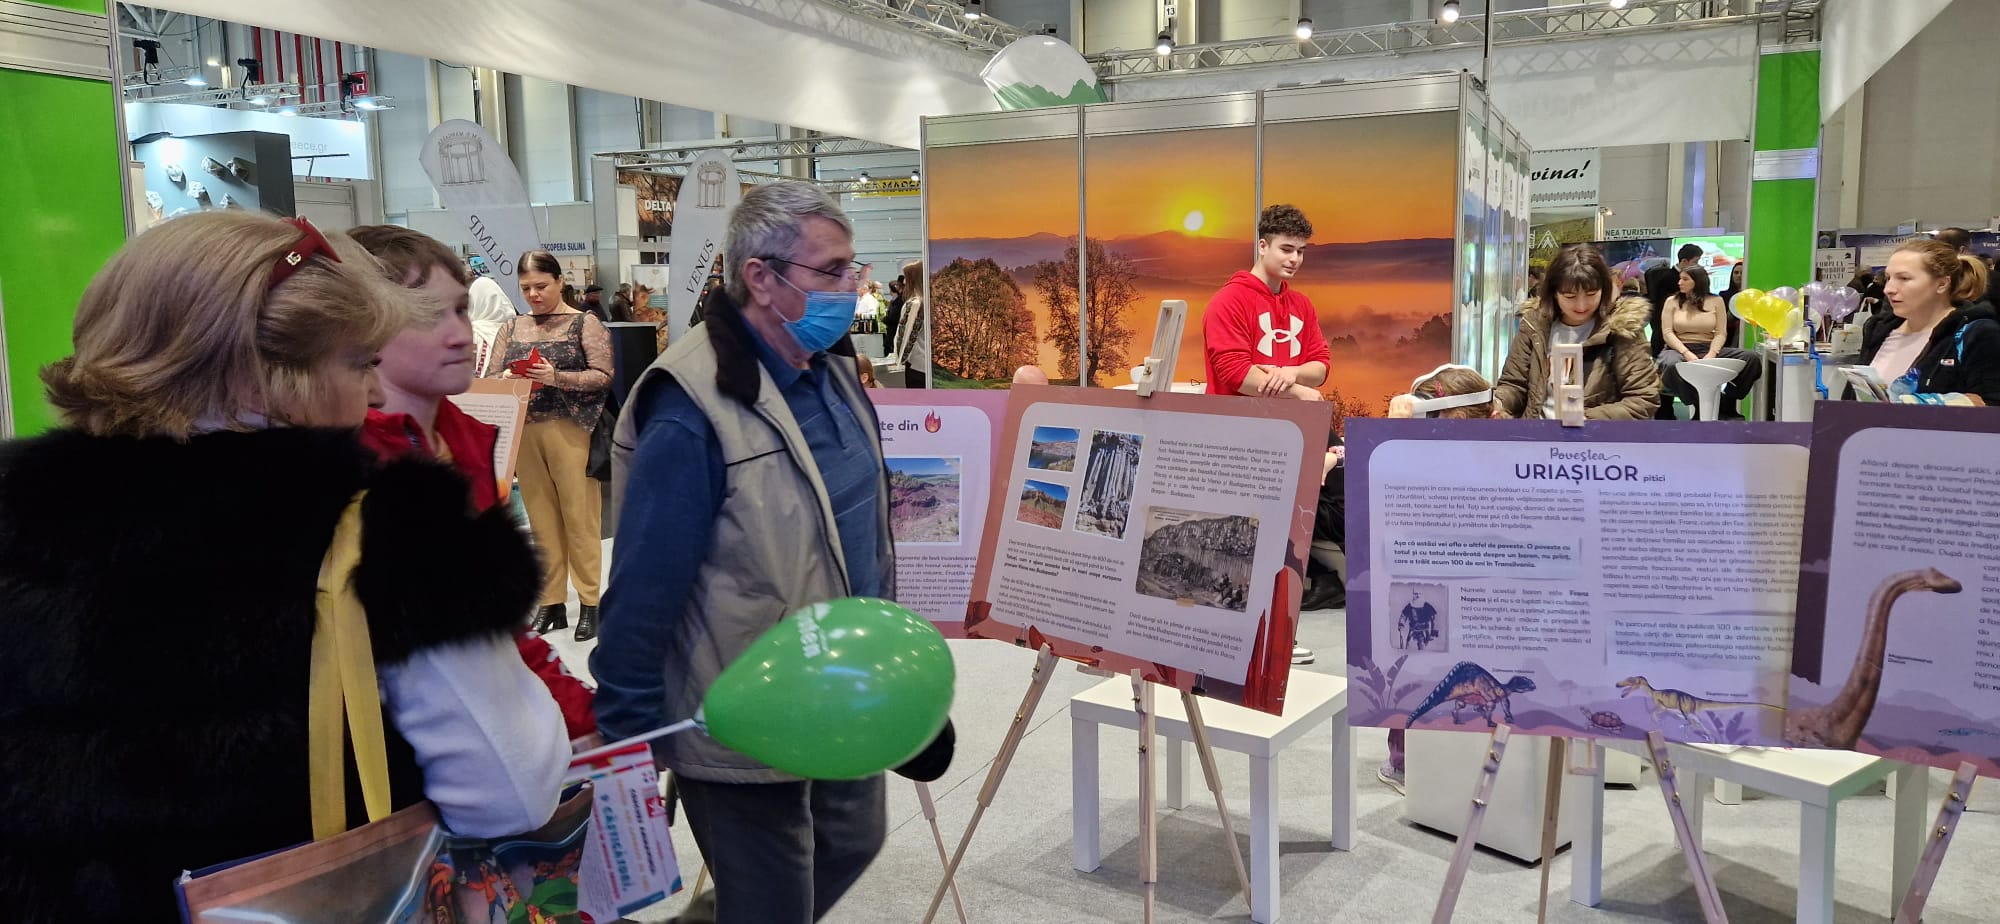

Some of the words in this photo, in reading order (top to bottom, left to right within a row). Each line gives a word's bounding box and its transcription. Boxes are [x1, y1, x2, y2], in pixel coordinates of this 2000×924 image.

[644, 200, 672, 212] DELTA
[1622, 228, 1661, 236] TURISTICA
[567, 242, 586, 251] SULINA
[686, 239, 714, 295] VENUS
[898, 419, 919, 431] din
[1515, 463, 1638, 485] URIAȘILOR
[1643, 474, 1666, 483] pitici
[1394, 539, 1406, 547] Așa
